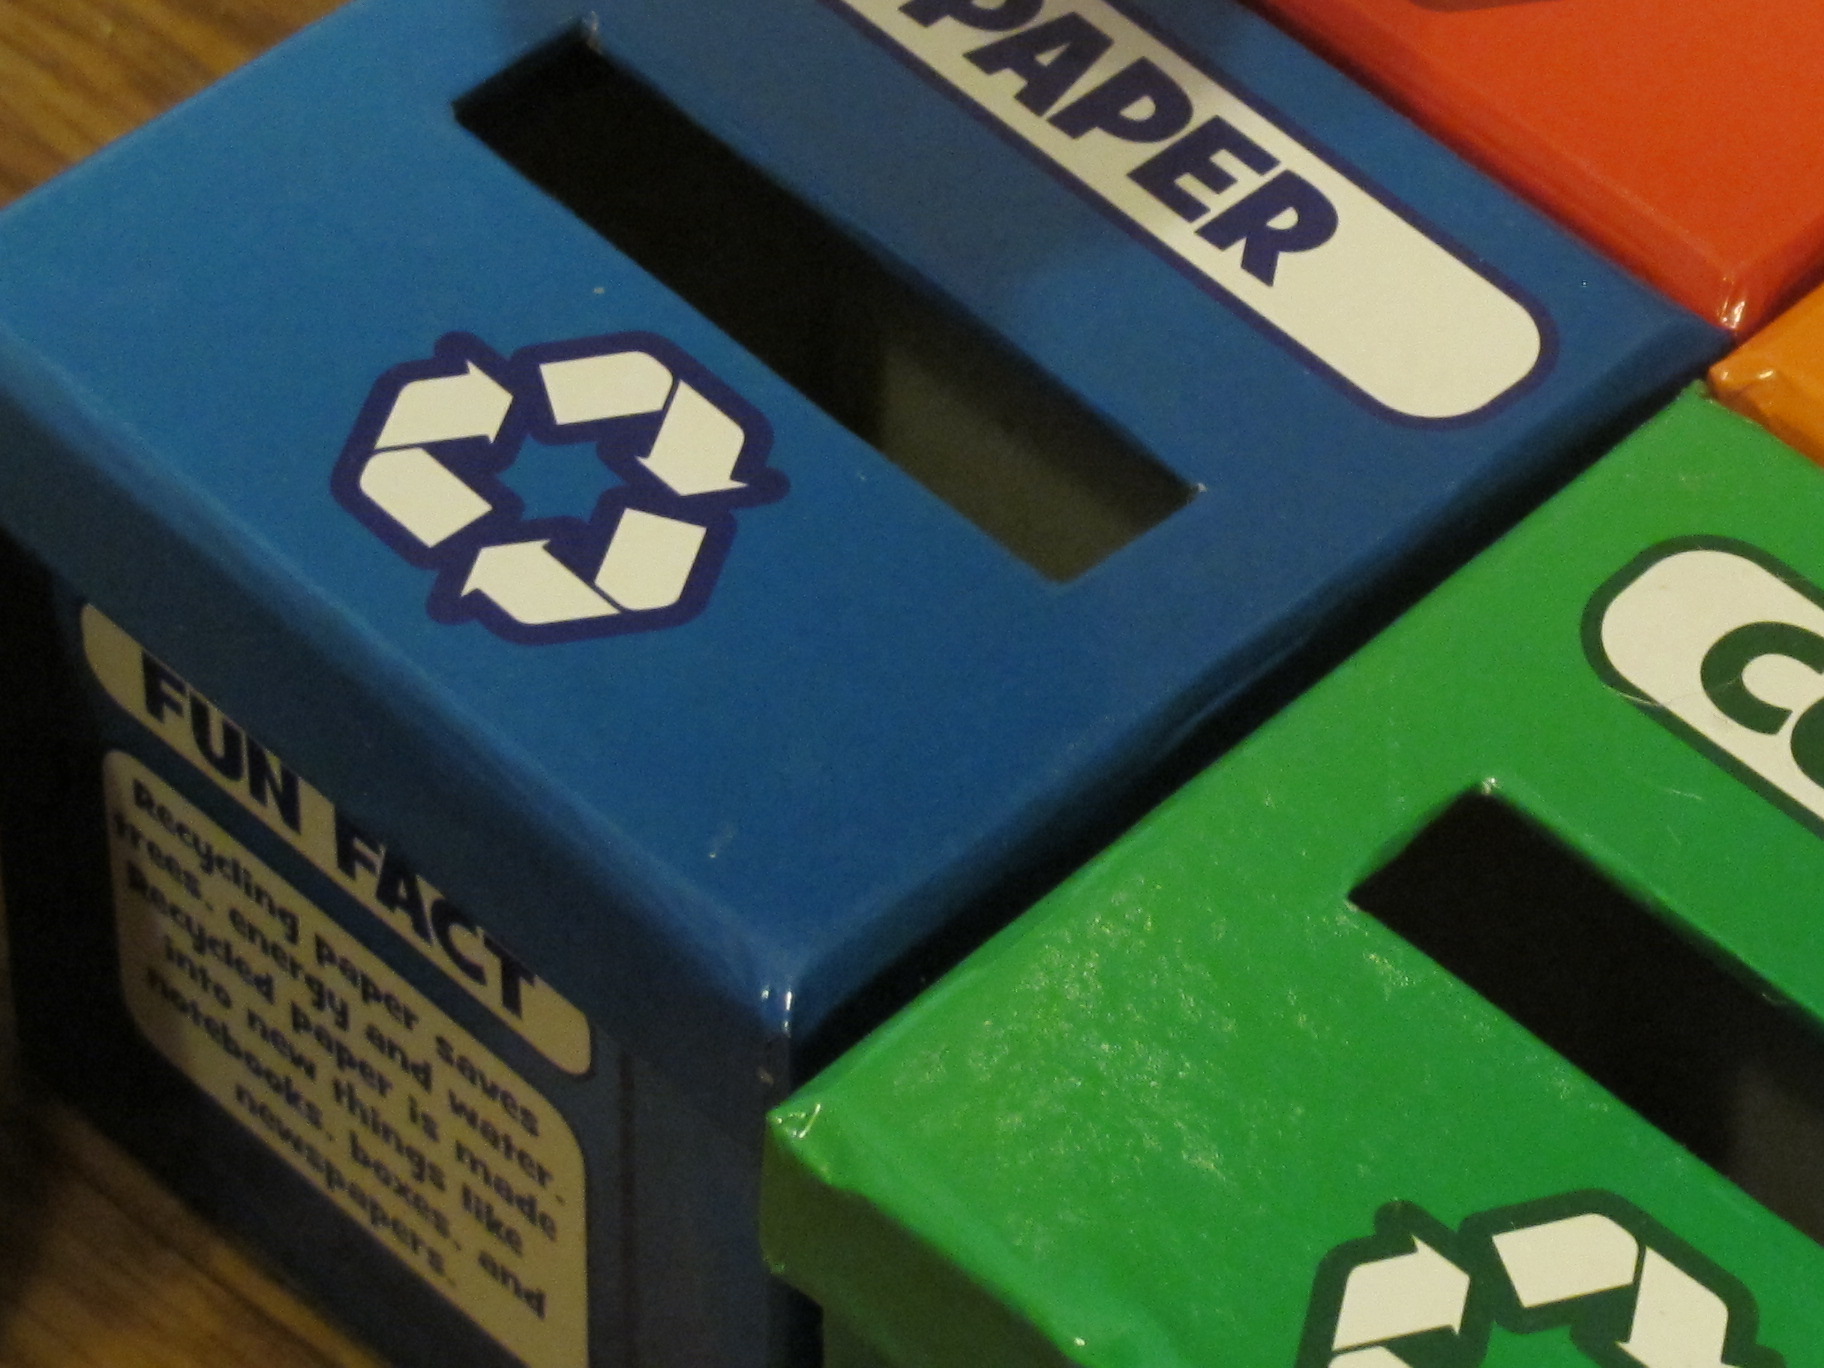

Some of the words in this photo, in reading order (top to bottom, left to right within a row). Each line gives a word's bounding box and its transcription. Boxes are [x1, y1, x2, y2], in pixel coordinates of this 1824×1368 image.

[134, 779, 300, 944] Recycling
[314, 932, 420, 1030] paper
[435, 1034, 539, 1137] saves
[143, 649, 301, 836] FUN
[335, 805, 535, 1021] FACT
[230, 907, 349, 1030] energy
[365, 1022, 432, 1094] and
[126, 862, 276, 1004] Recycled
[292, 1001, 393, 1099] paper
[408, 1094, 439, 1144] is
[455, 1137, 557, 1243] made
[165, 935, 232, 1009] into
[247, 1009, 317, 1082] new
[333, 1077, 446, 1192] things
[462, 1183, 523, 1258] like
[478, 1250, 548, 1320] and
